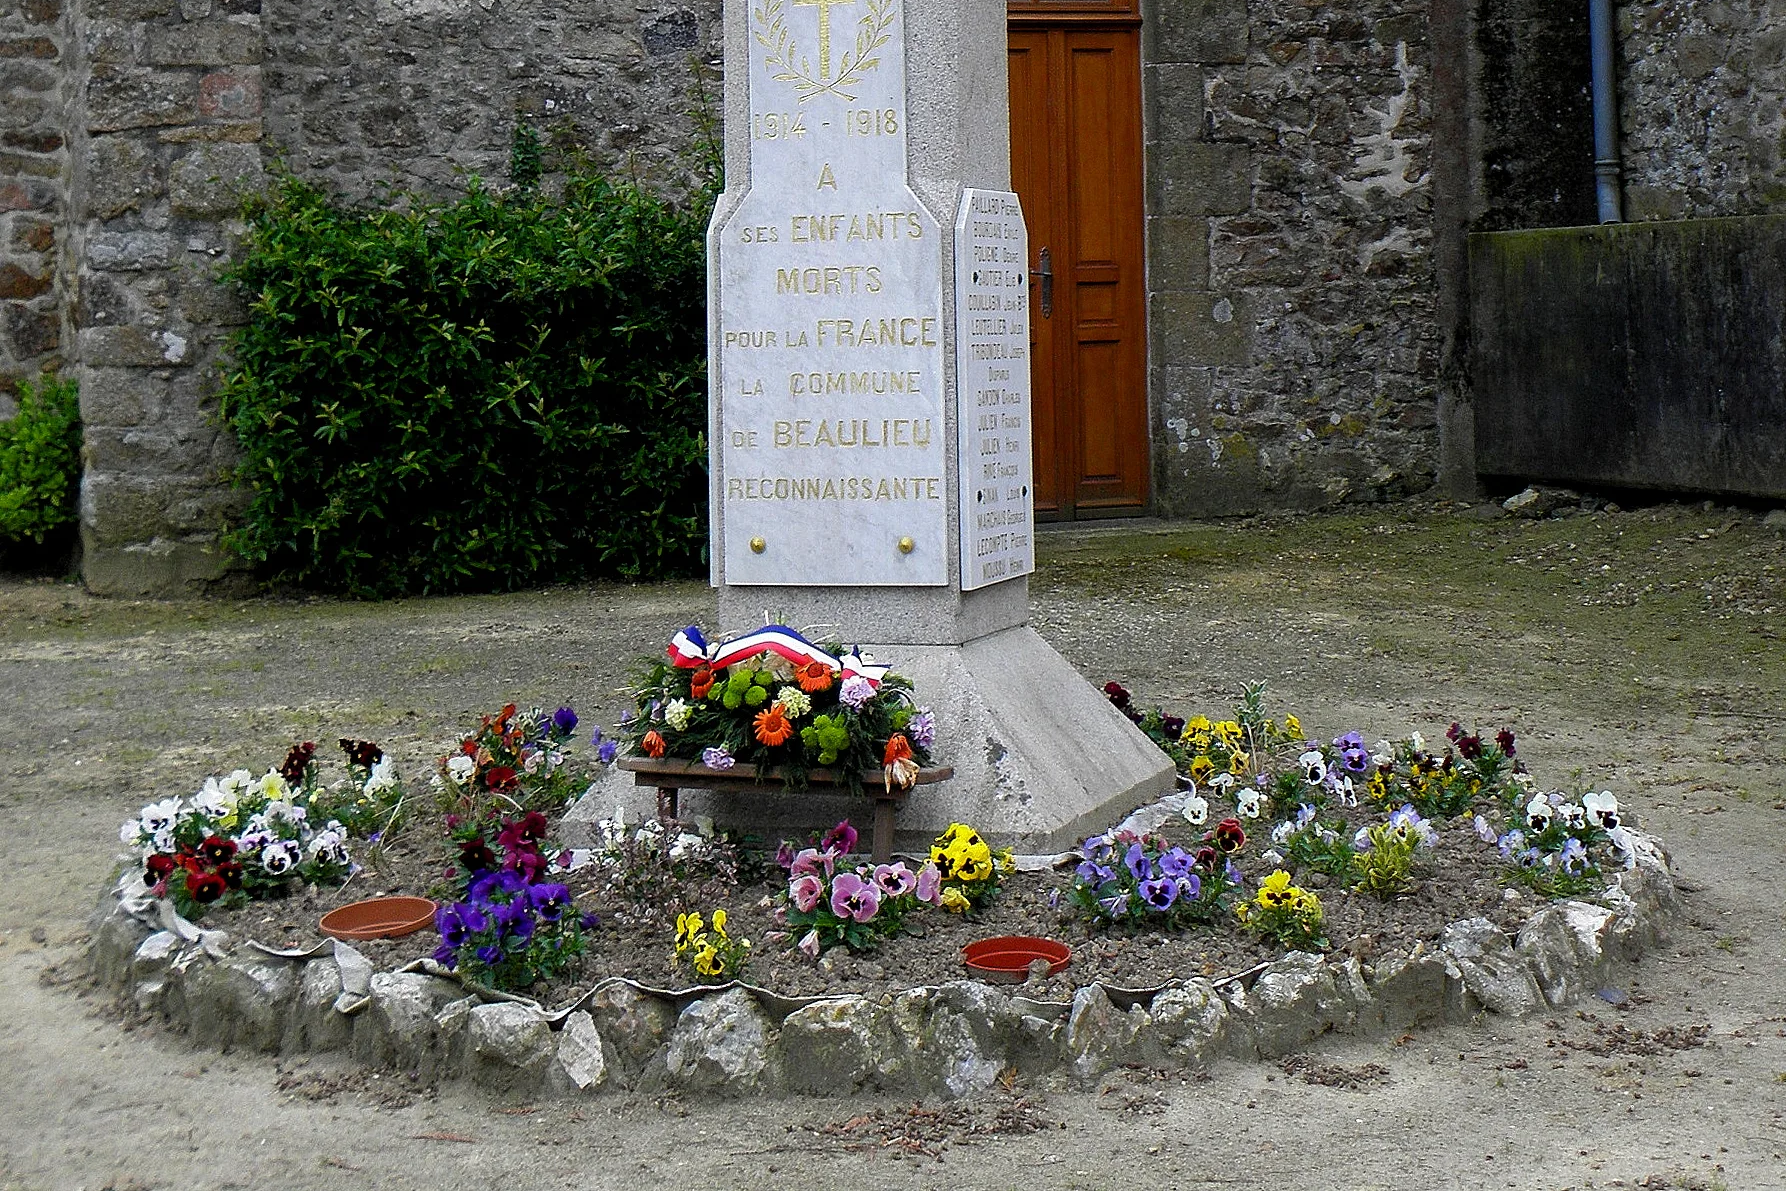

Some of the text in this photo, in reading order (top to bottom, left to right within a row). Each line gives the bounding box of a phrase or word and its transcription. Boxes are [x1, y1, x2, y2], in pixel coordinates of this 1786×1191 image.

[754, 112, 807, 140] 1914
[847, 108, 899, 136] 1918
[817, 163, 838, 191] A
[741, 212, 923, 243] SES ENFANTS
[776, 266, 882, 295] MORTS
[725, 318, 937, 348] POUR LA FRANCE
[741, 371, 921, 396] LA COMMUNE
[732, 419, 931, 449] DE BEAULIEU
[727, 477, 940, 502] RECONNAISSANTE
